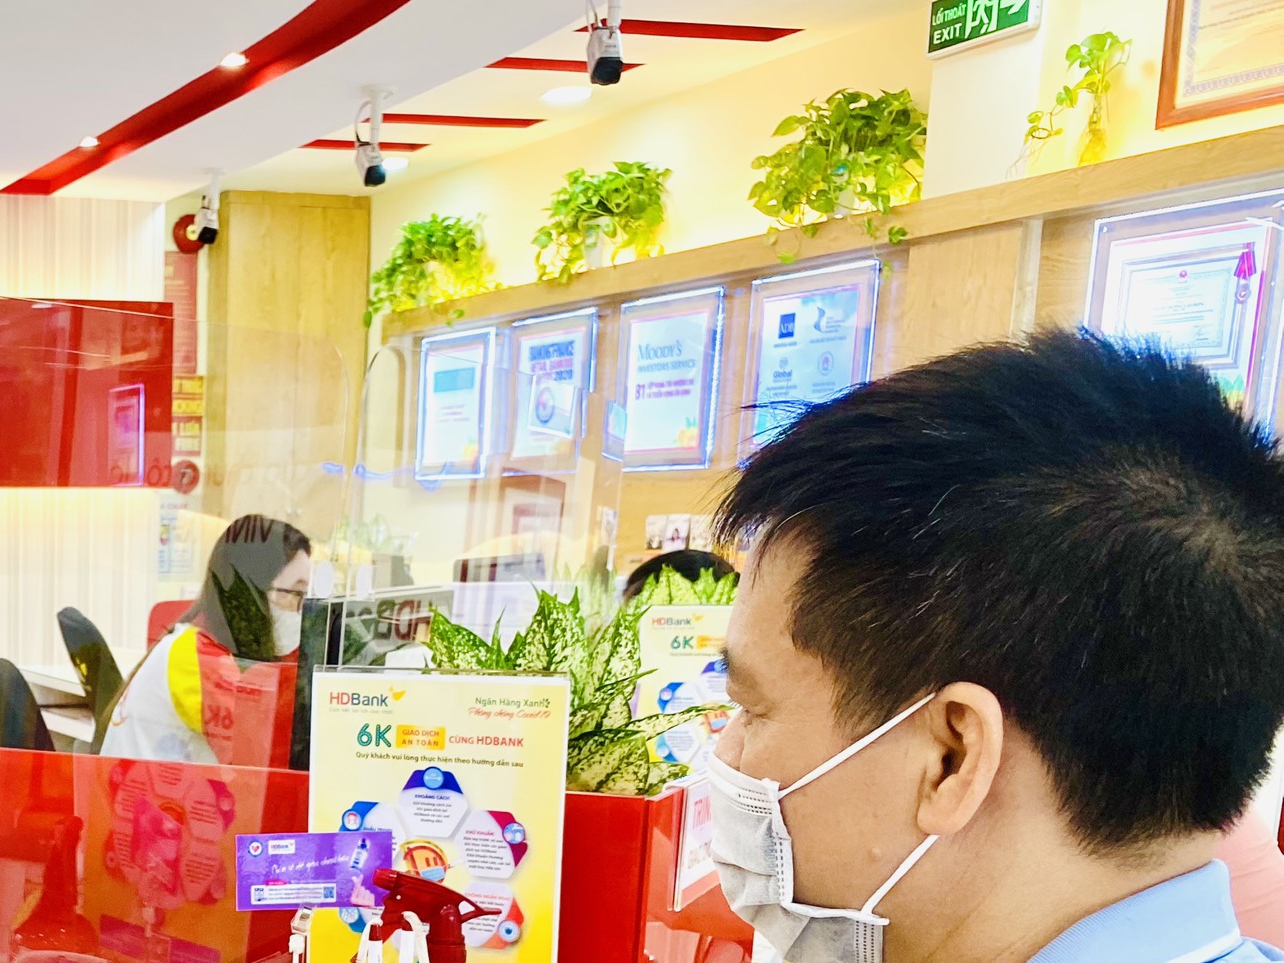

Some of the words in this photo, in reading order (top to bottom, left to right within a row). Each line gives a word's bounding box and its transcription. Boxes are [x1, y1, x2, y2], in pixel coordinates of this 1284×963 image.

[933, 23, 962, 44] EXIT
[670, 635, 694, 650] 6K
[329, 691, 388, 707] HDBank
[475, 697, 496, 706] Ngân
[499, 698, 520, 708] Hàng
[523, 699, 545, 707] Xanh
[357, 723, 392, 748] 6K
[402, 729, 420, 737] GIAO
[449, 735, 474, 745] CÙNG
[476, 736, 524, 748] HDBANK
[404, 754, 418, 762] lòng
[437, 756, 453, 764] hiện
[472, 758, 494, 766] hướng
